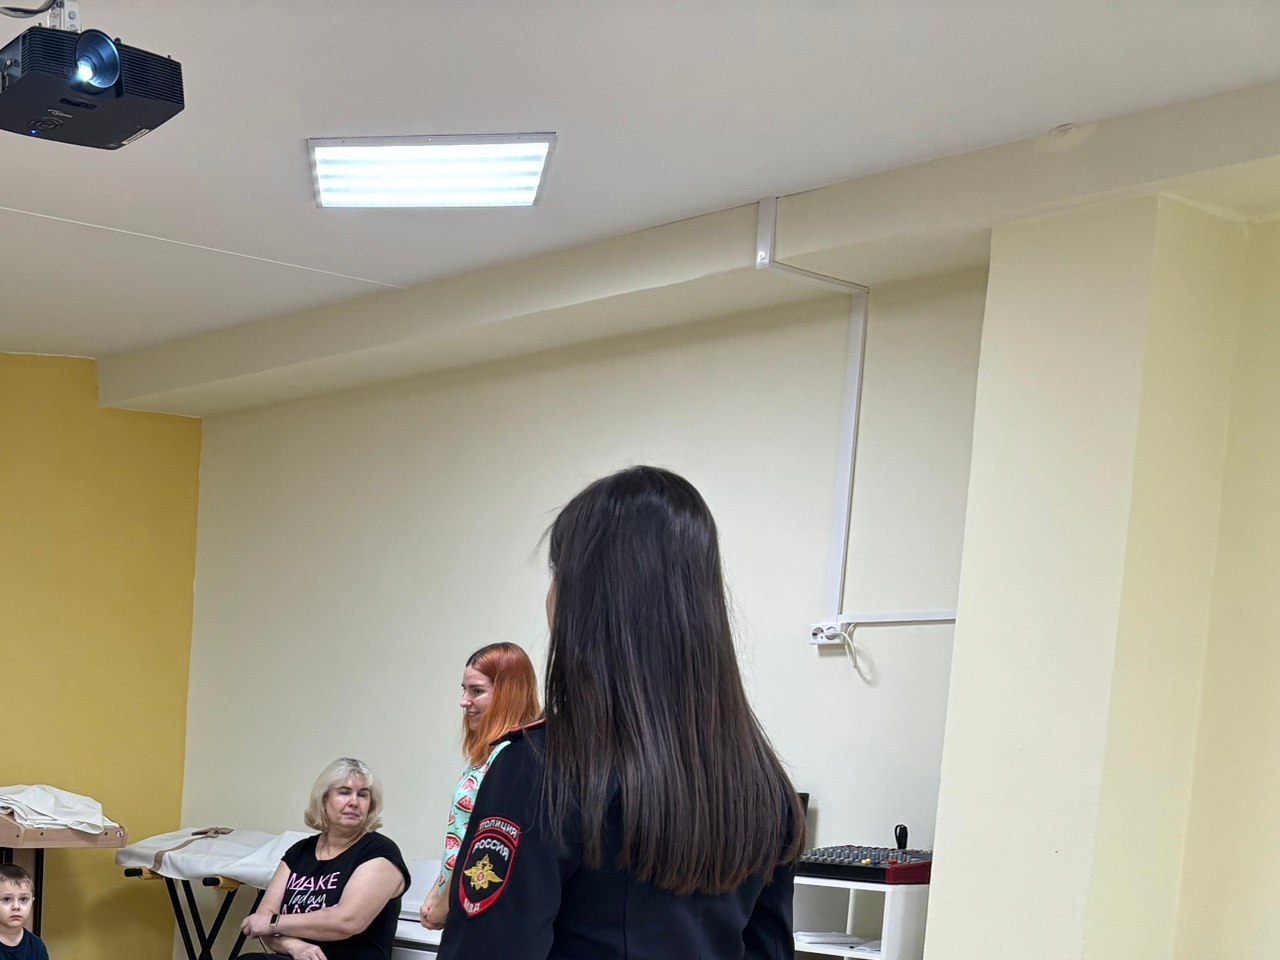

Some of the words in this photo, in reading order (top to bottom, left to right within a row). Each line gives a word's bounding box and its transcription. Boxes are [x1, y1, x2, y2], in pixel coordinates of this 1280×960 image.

[480, 819, 518, 838] ПОЛИЦИЯ
[472, 838, 510, 861] РОССИЯ
[287, 871, 341, 891] MAKE
[463, 897, 480, 913] МВД
